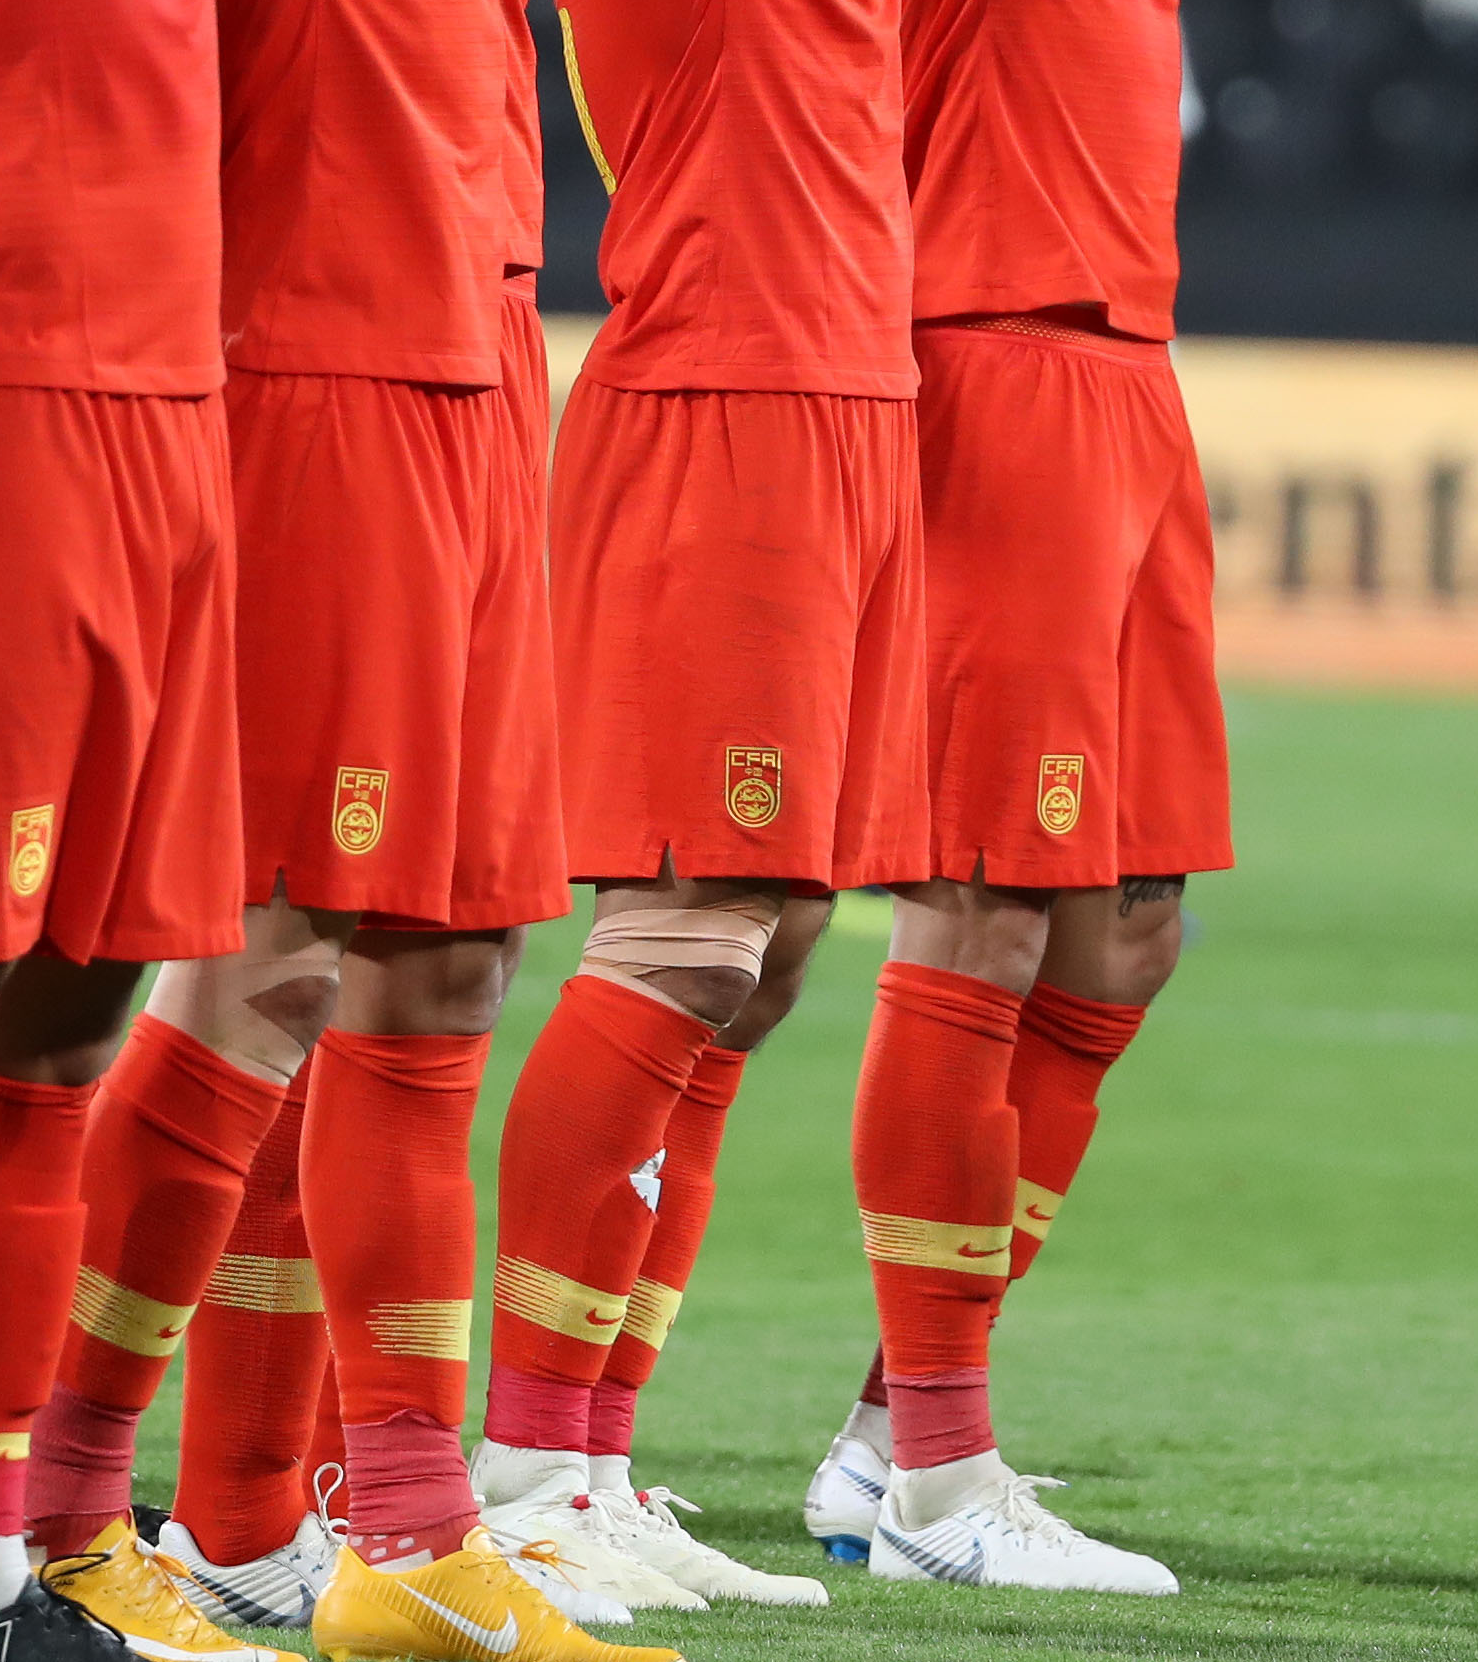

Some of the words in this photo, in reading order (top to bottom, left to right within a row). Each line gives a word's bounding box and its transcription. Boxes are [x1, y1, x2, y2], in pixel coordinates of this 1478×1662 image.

[730, 751, 776, 768] CFA
[1044, 760, 1079, 775] CFA
[341, 772, 384, 792] CFA
